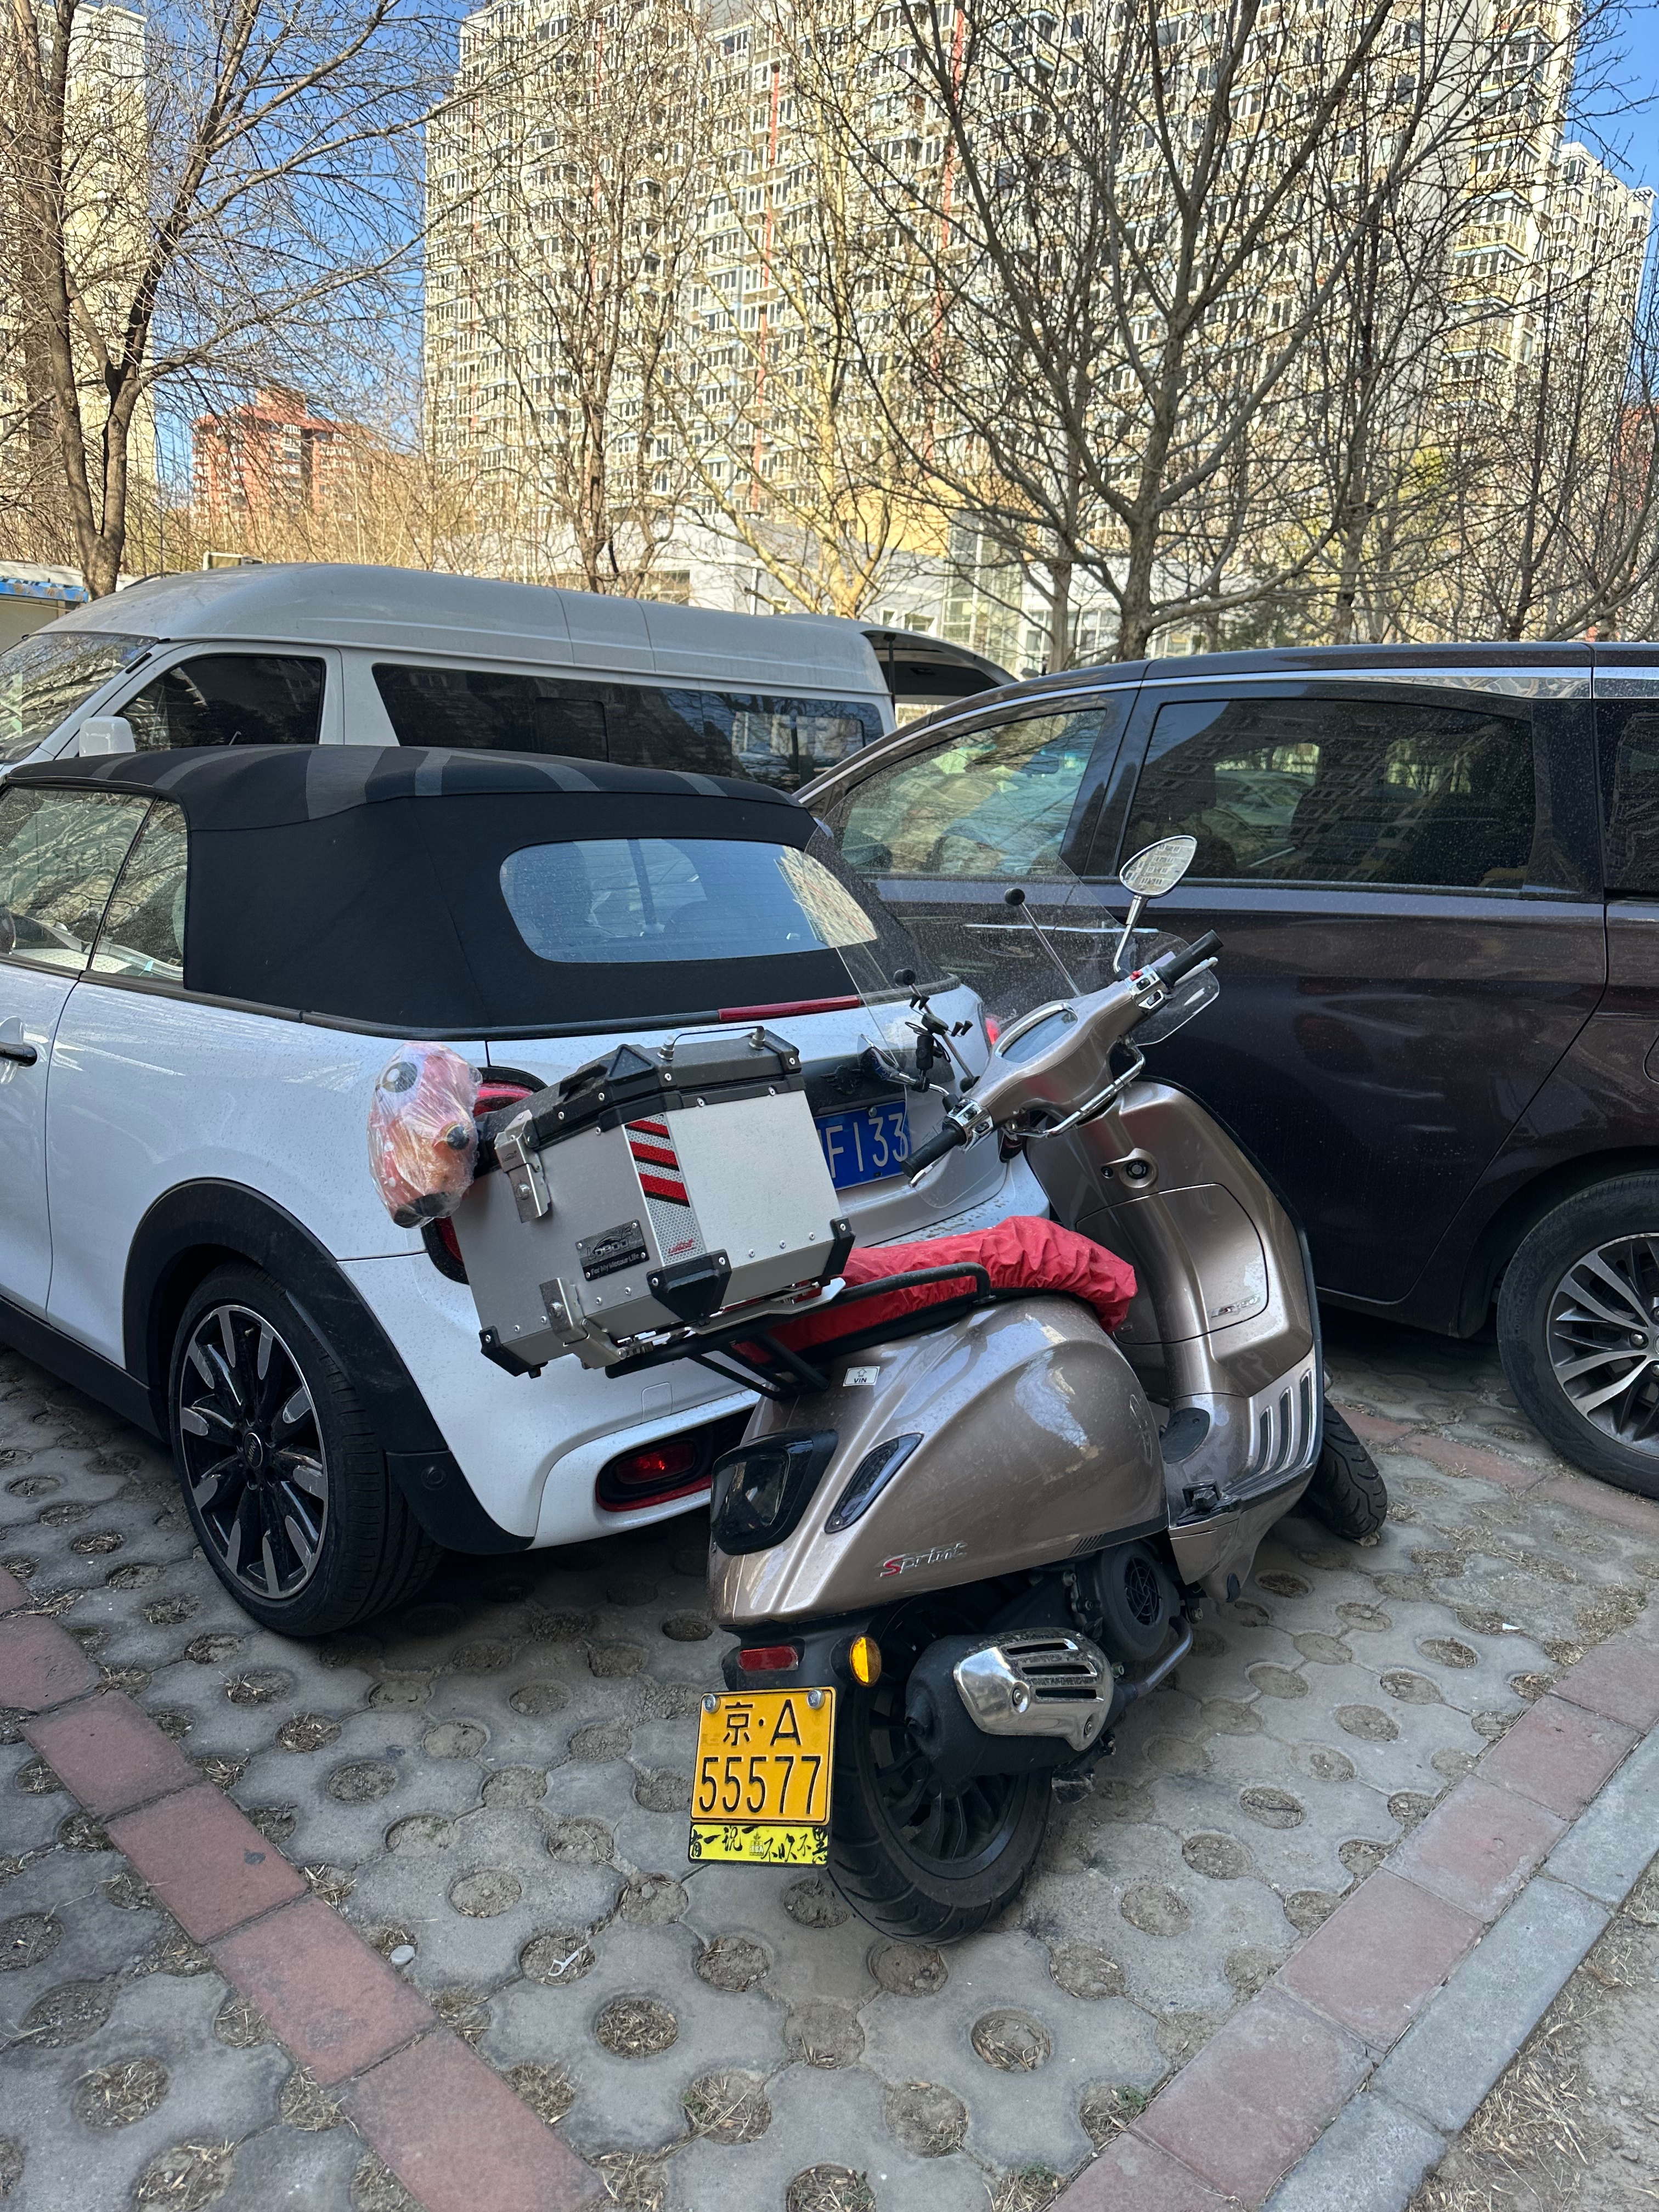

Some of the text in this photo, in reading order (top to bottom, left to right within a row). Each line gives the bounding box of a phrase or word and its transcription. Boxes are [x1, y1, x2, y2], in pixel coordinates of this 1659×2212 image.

[818, 1113, 909, 1178] F133
[247, 1439, 257, 1462] MINI
[879, 1540, 968, 1578] Sprint
[699, 1756, 821, 1814] 55577
